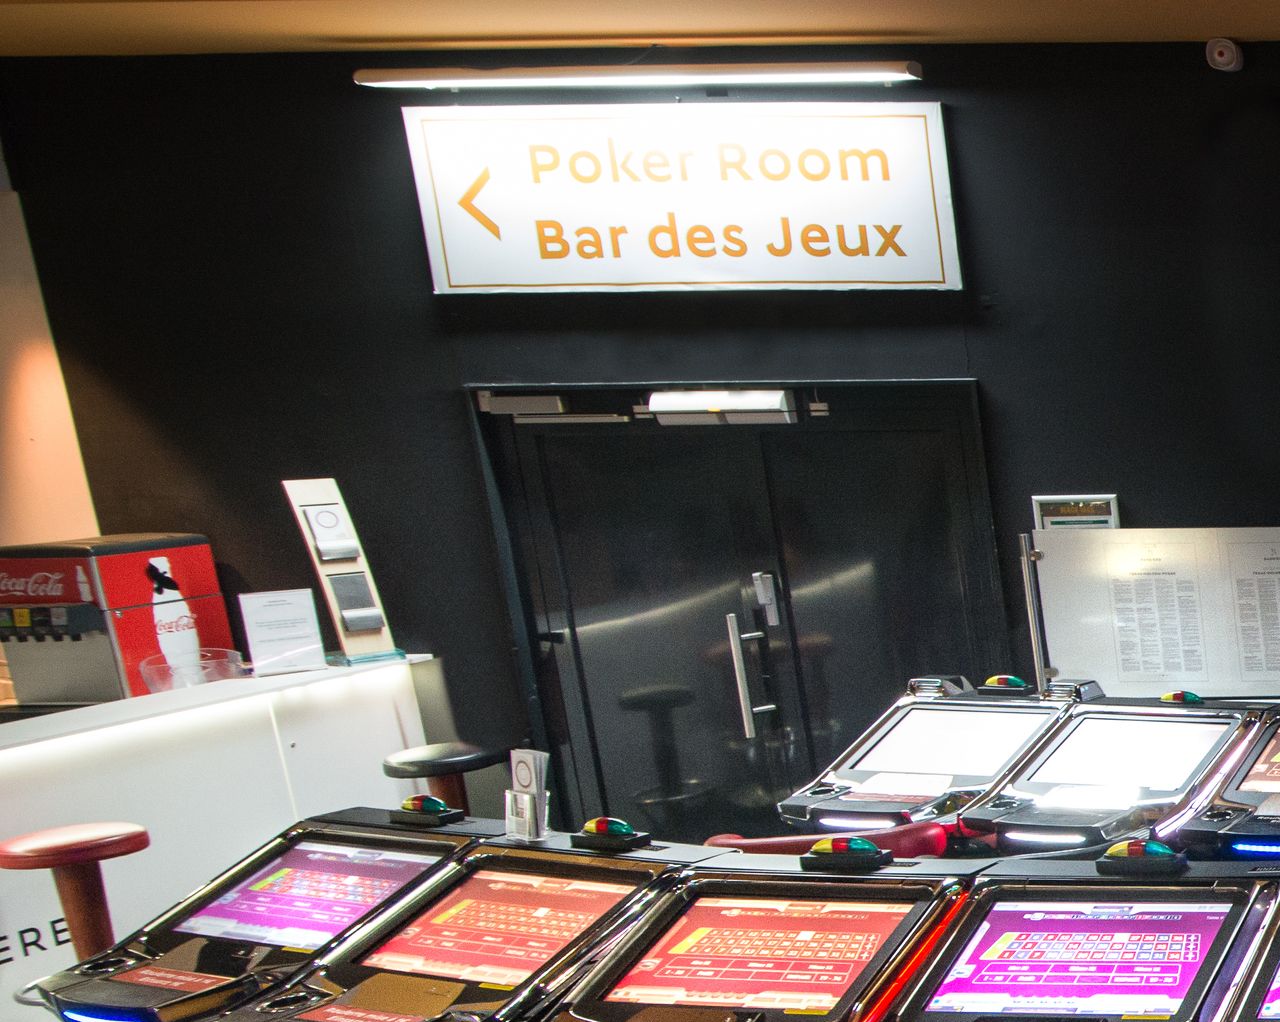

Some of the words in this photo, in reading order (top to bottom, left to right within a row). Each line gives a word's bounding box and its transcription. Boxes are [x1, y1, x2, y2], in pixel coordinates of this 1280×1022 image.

[528, 138, 693, 184] Poker
[718, 142, 890, 182] Room
[534, 219, 628, 260] Bar
[648, 212, 747, 258] des
[766, 217, 908, 258] Jeux
